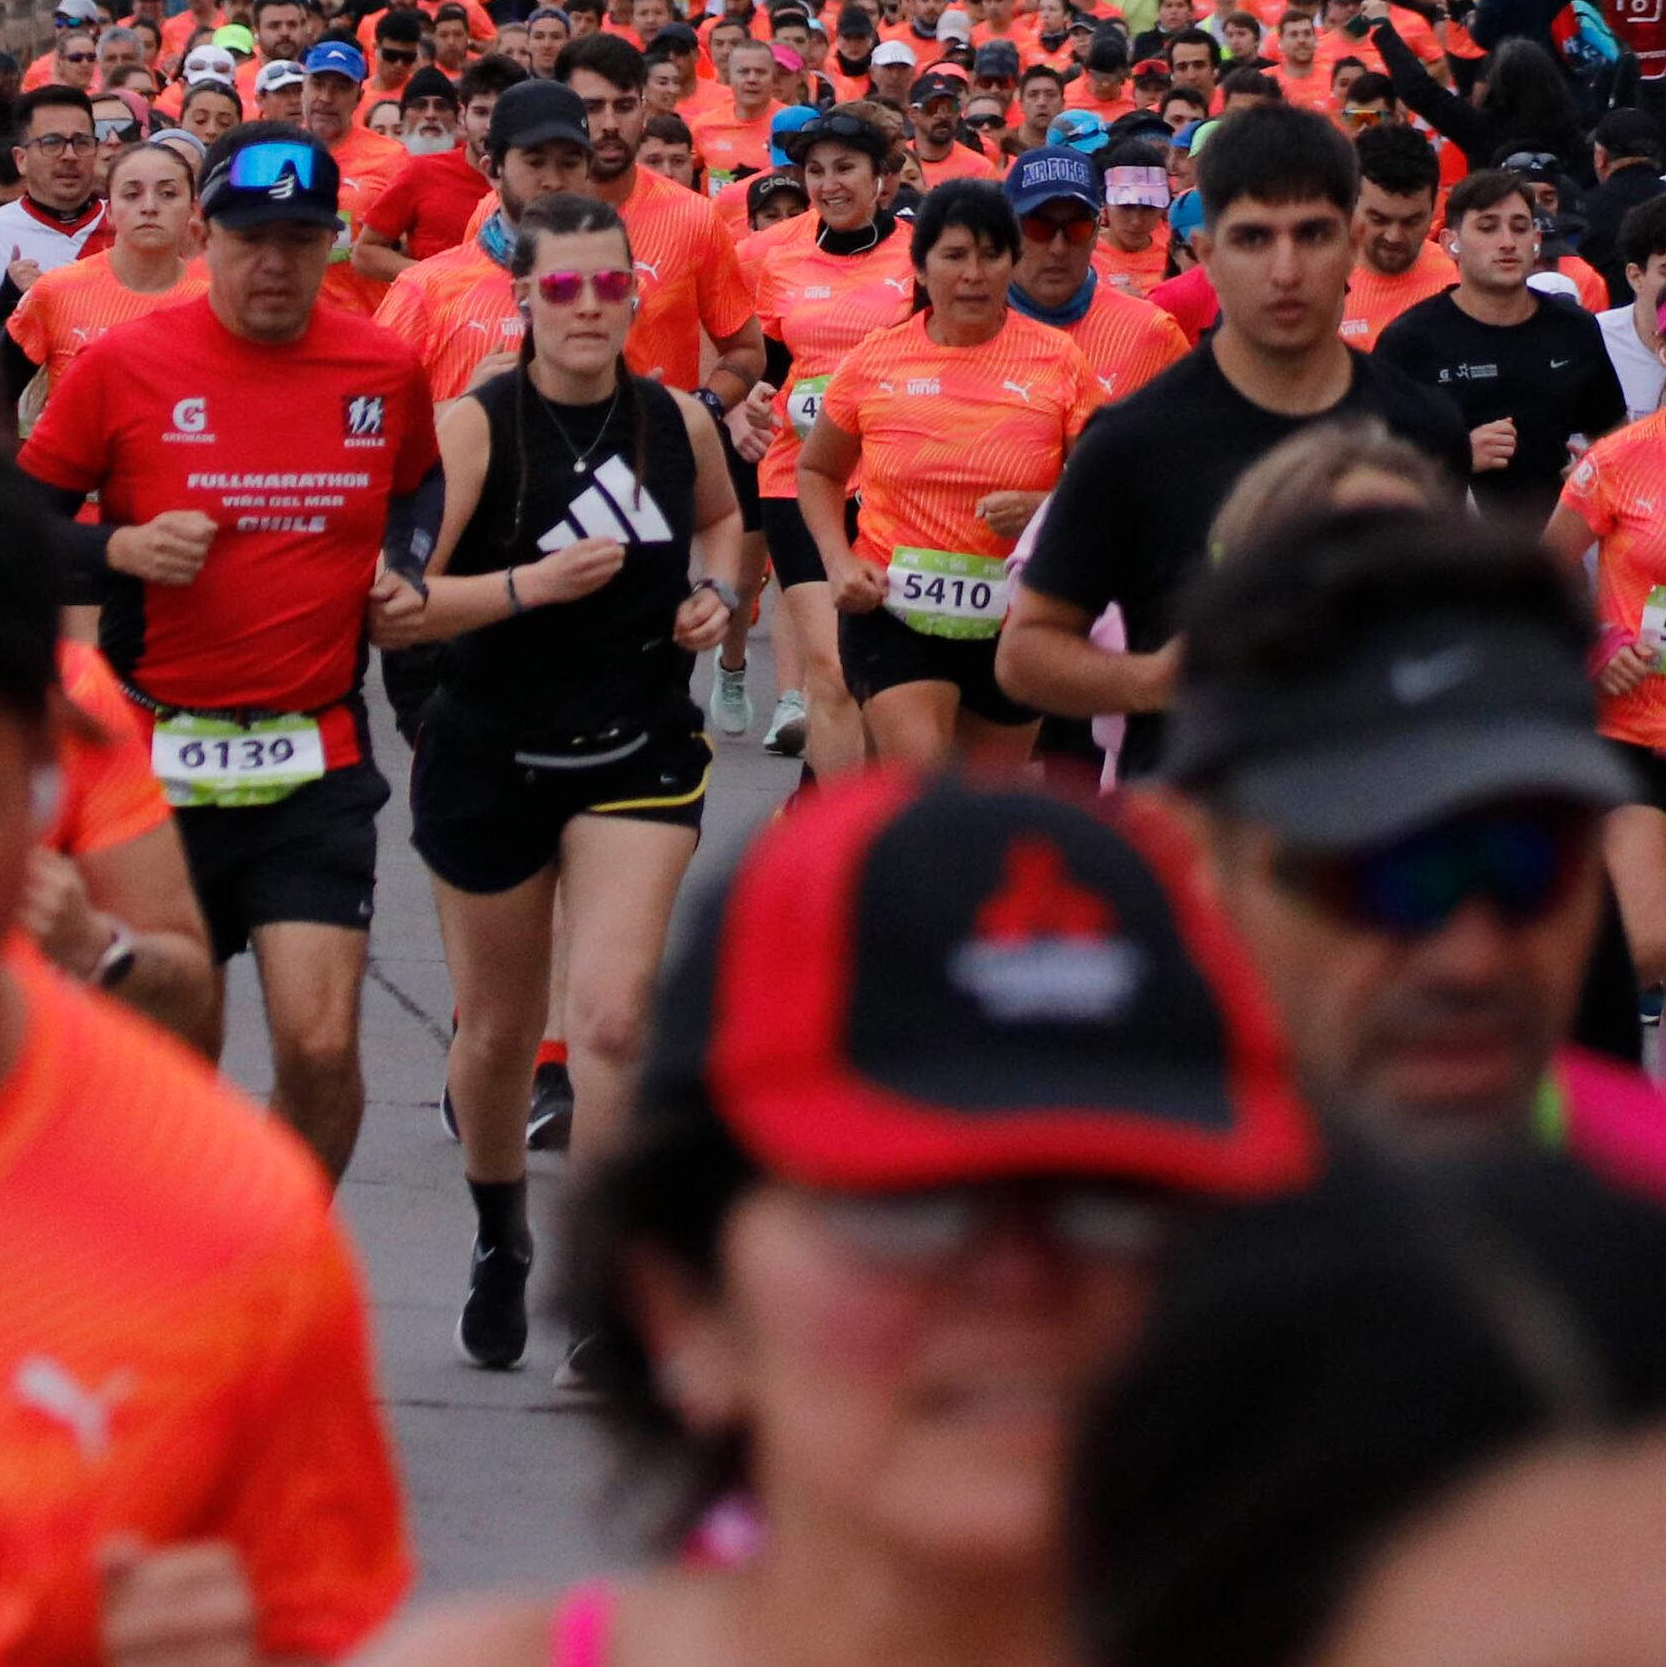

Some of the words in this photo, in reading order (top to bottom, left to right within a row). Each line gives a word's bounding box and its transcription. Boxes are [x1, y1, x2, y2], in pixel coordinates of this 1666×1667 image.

[1022, 161, 1047, 188] AIR
[1048, 158, 1090, 188] FORCE
[172, 398, 204, 432] G
[162, 433, 216, 442] GATORADE
[344, 438, 384, 447] CHILE
[187, 473, 369, 489] FULLMARATHON
[269, 496, 301, 507] DEL
[305, 496, 344, 507] MAR
[237, 515, 327, 533] CHILE
[902, 574, 991, 609] 5410
[179, 738, 294, 772] 6139
